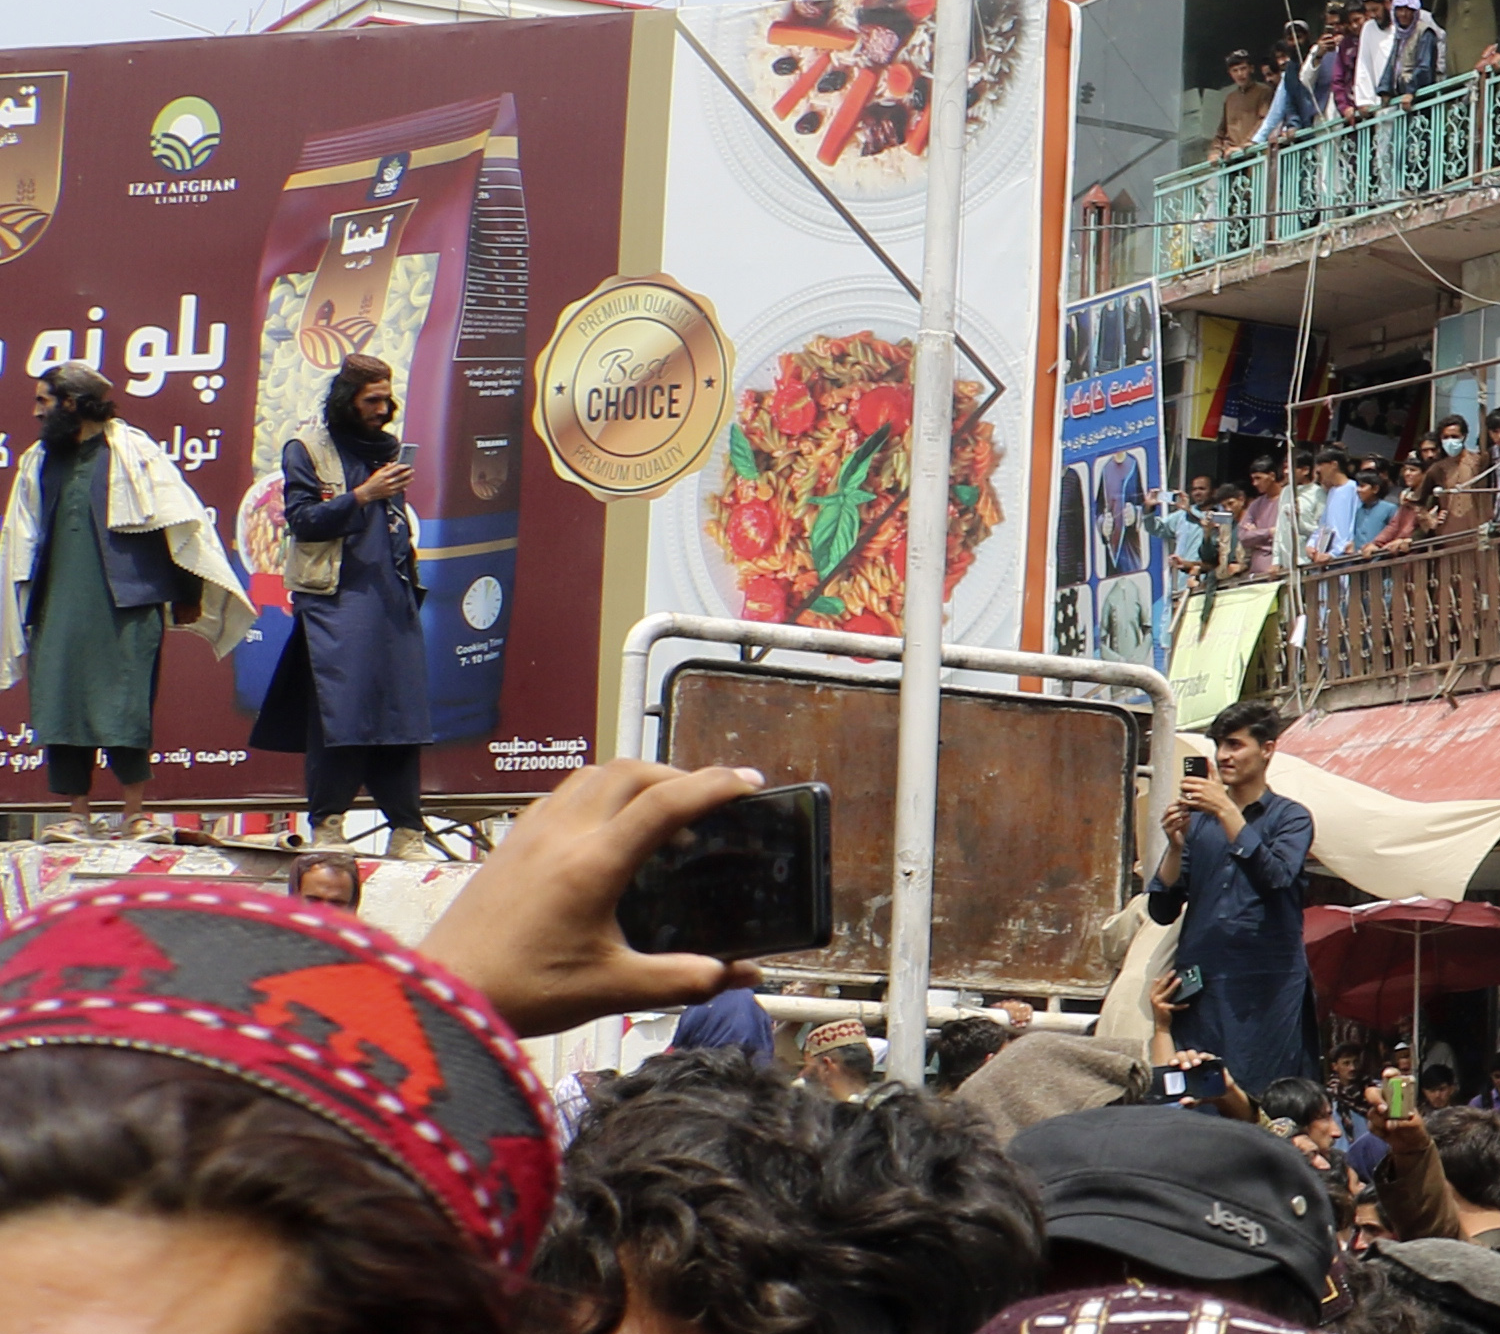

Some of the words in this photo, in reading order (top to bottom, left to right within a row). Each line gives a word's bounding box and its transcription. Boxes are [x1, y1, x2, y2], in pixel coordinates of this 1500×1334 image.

[128, 182, 165, 197] IZAT
[167, 177, 236, 195] AFGHAN
[155, 193, 209, 205] LIMITED
[577, 294, 640, 339] PREMIUM
[643, 293, 698, 331] QUALITY
[597, 348, 673, 385] Best
[586, 383, 682, 422] CHOICE
[572, 443, 630, 481] PREMIUM
[633, 441, 686, 481] QUALITY
[455, 644, 486, 657] Cooking
[494, 755, 584, 772] 0272000800
